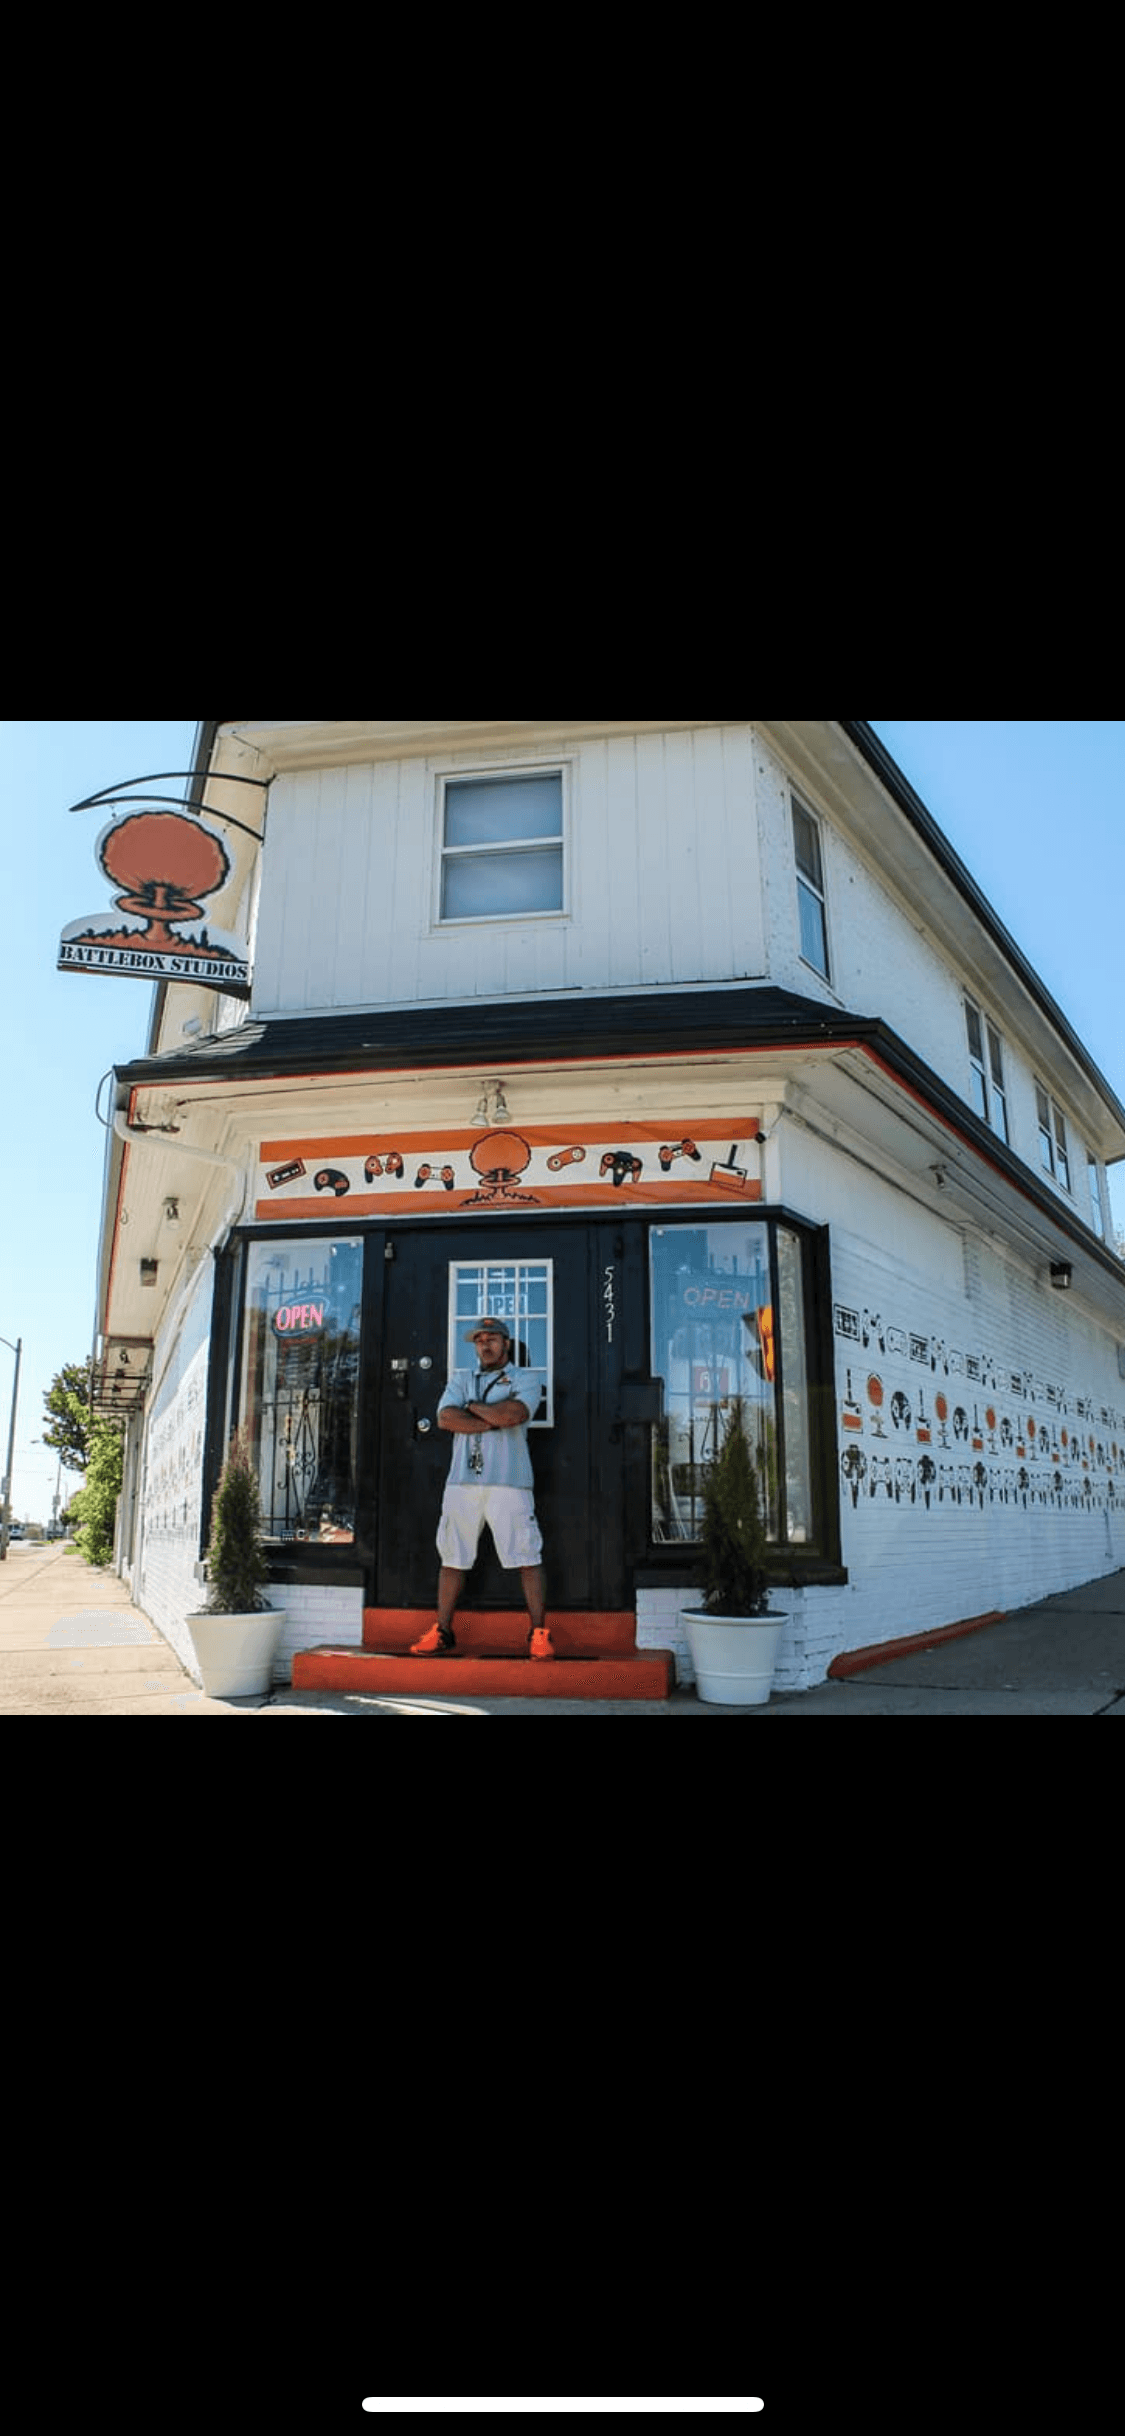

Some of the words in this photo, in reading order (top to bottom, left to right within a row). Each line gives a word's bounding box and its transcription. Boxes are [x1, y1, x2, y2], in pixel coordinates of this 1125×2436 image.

[60, 946, 166, 970] BATTLEBOX
[170, 957, 248, 978] STUDIOS
[603, 1265, 616, 1343] 5431
[683, 1286, 750, 1309] OPEN
[275, 1304, 323, 1330] OPEN
